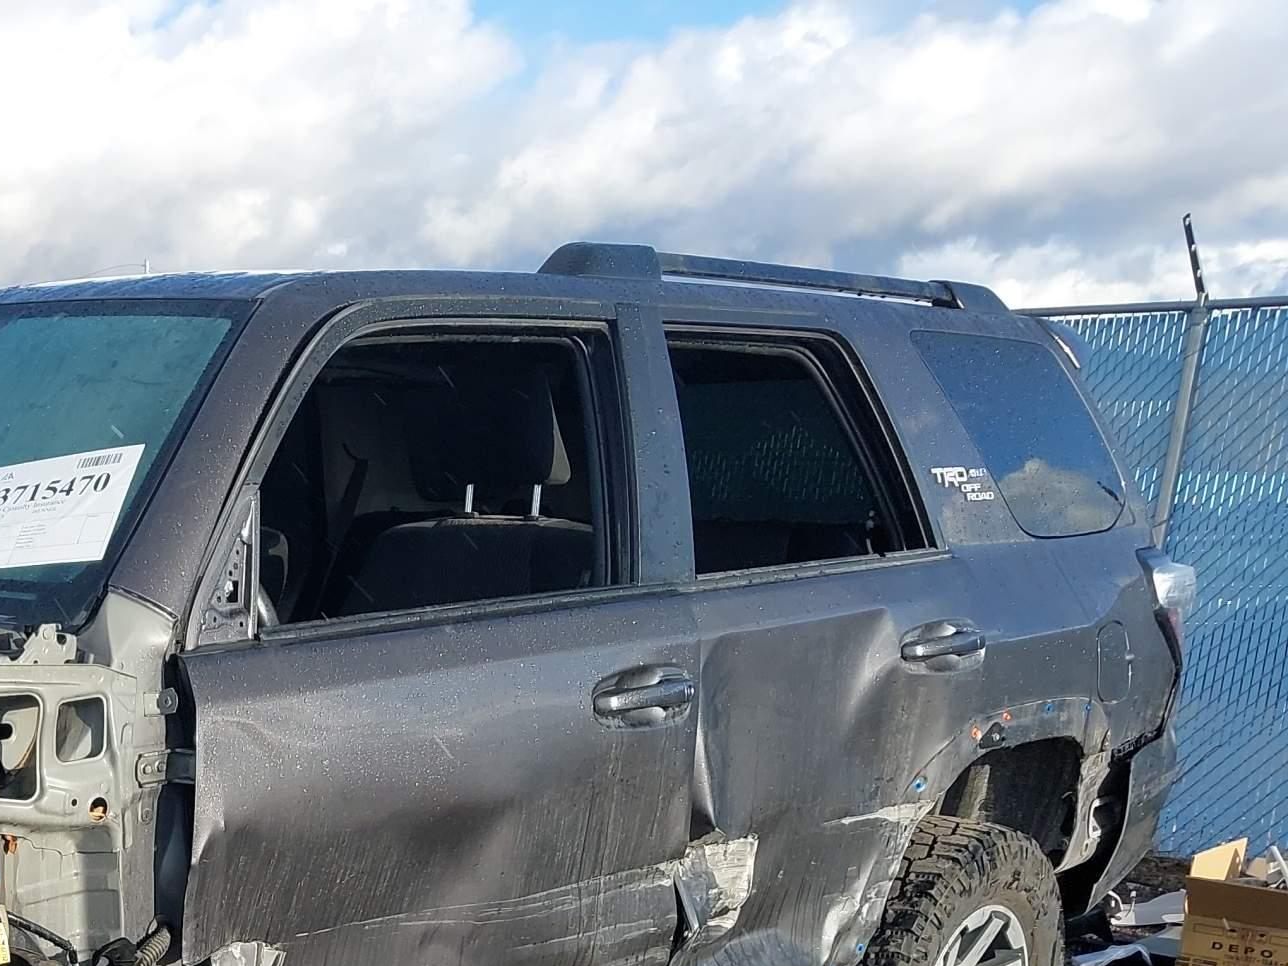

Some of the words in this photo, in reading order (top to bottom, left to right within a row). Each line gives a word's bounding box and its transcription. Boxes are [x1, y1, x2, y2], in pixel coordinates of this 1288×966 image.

[931, 466, 968, 488] TRD
[961, 483, 981, 492] OFF
[967, 491, 995, 501] ROAD
[1211, 941, 1274, 959] DEPO
